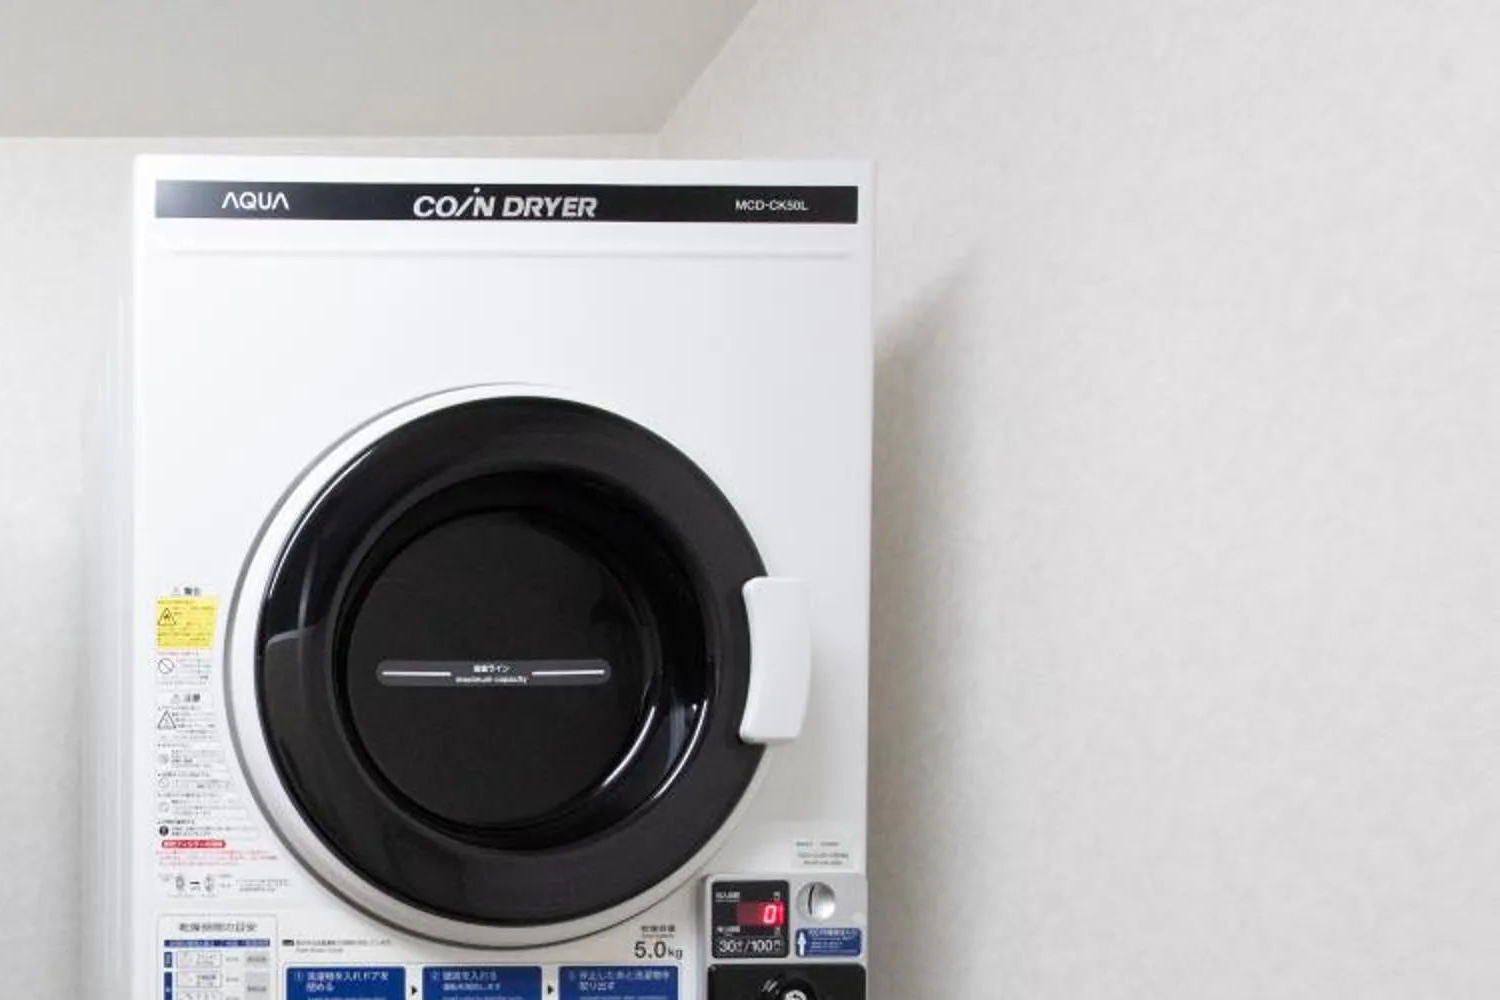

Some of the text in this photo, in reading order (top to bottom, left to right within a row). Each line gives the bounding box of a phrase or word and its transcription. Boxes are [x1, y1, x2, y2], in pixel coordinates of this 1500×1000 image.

[221, 191, 290, 210] AQUA
[501, 196, 598, 217] DRYER
[735, 199, 809, 211] MCD-CK50L
[762, 904, 778, 925] 0
